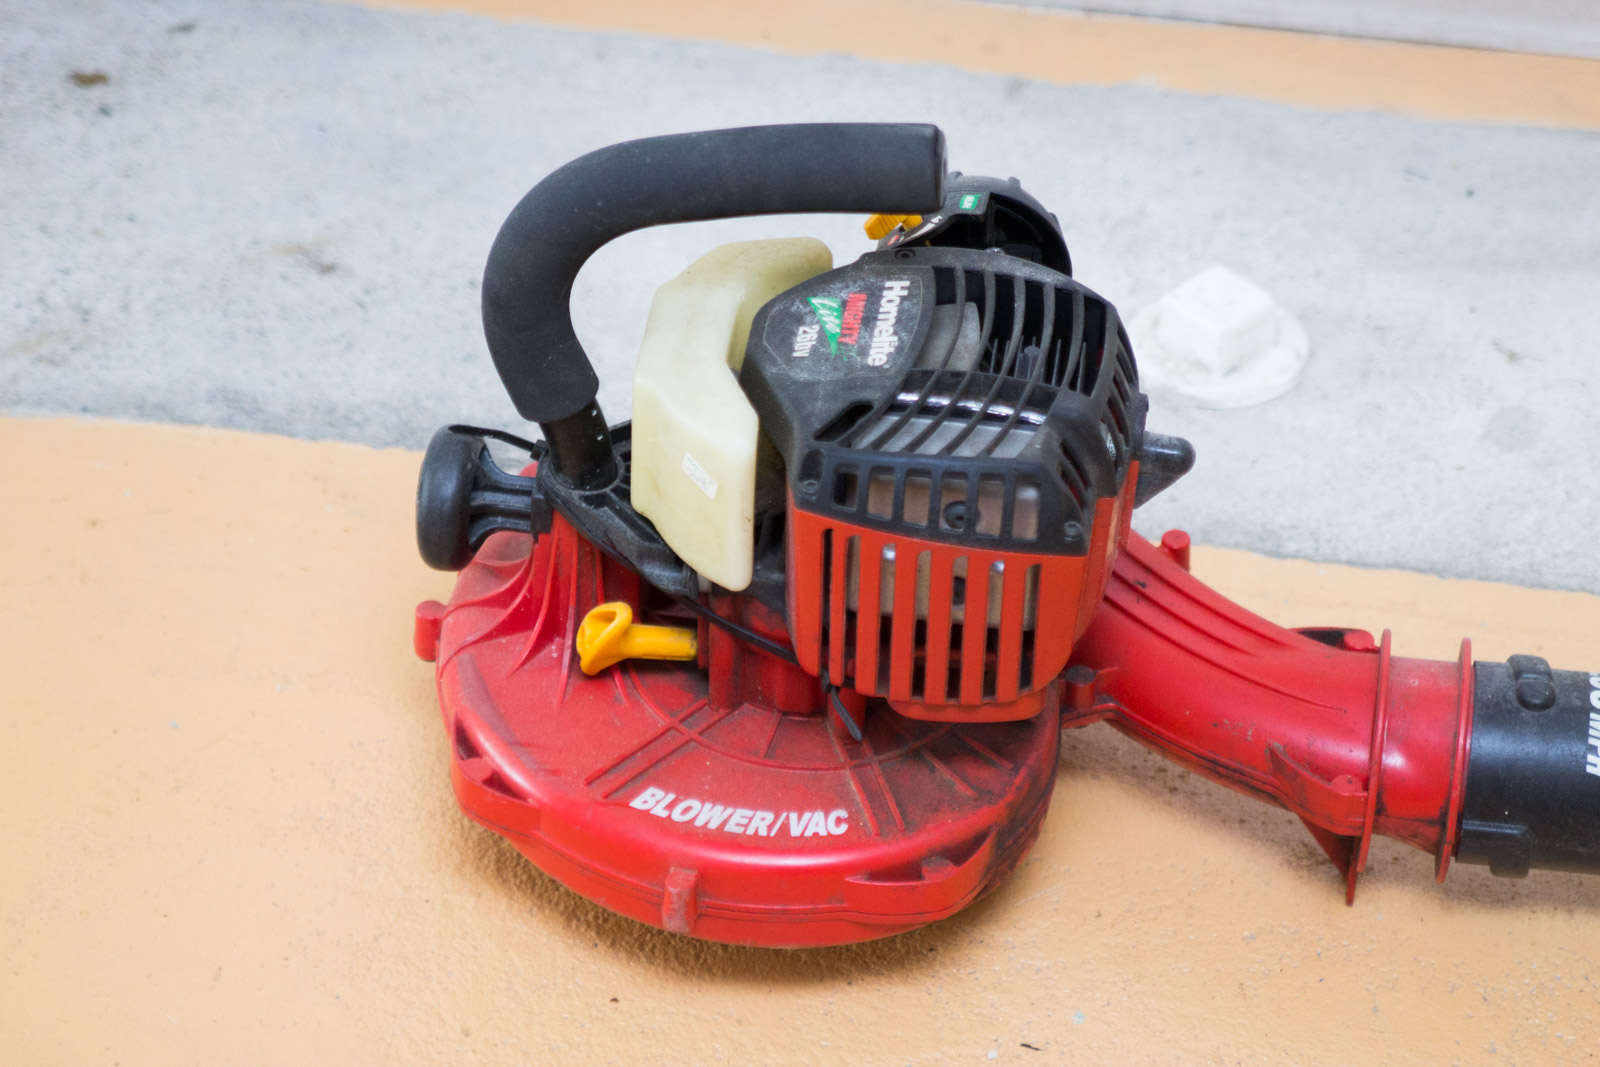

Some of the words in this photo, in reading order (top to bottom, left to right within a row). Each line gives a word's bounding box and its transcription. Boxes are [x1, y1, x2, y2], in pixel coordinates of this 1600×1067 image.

[811, 298, 840, 334] Lite
[838, 293, 867, 345] MIGHTY
[867, 280, 910, 367] Homelite
[629, 786, 849, 837] BLOWER/VAC
